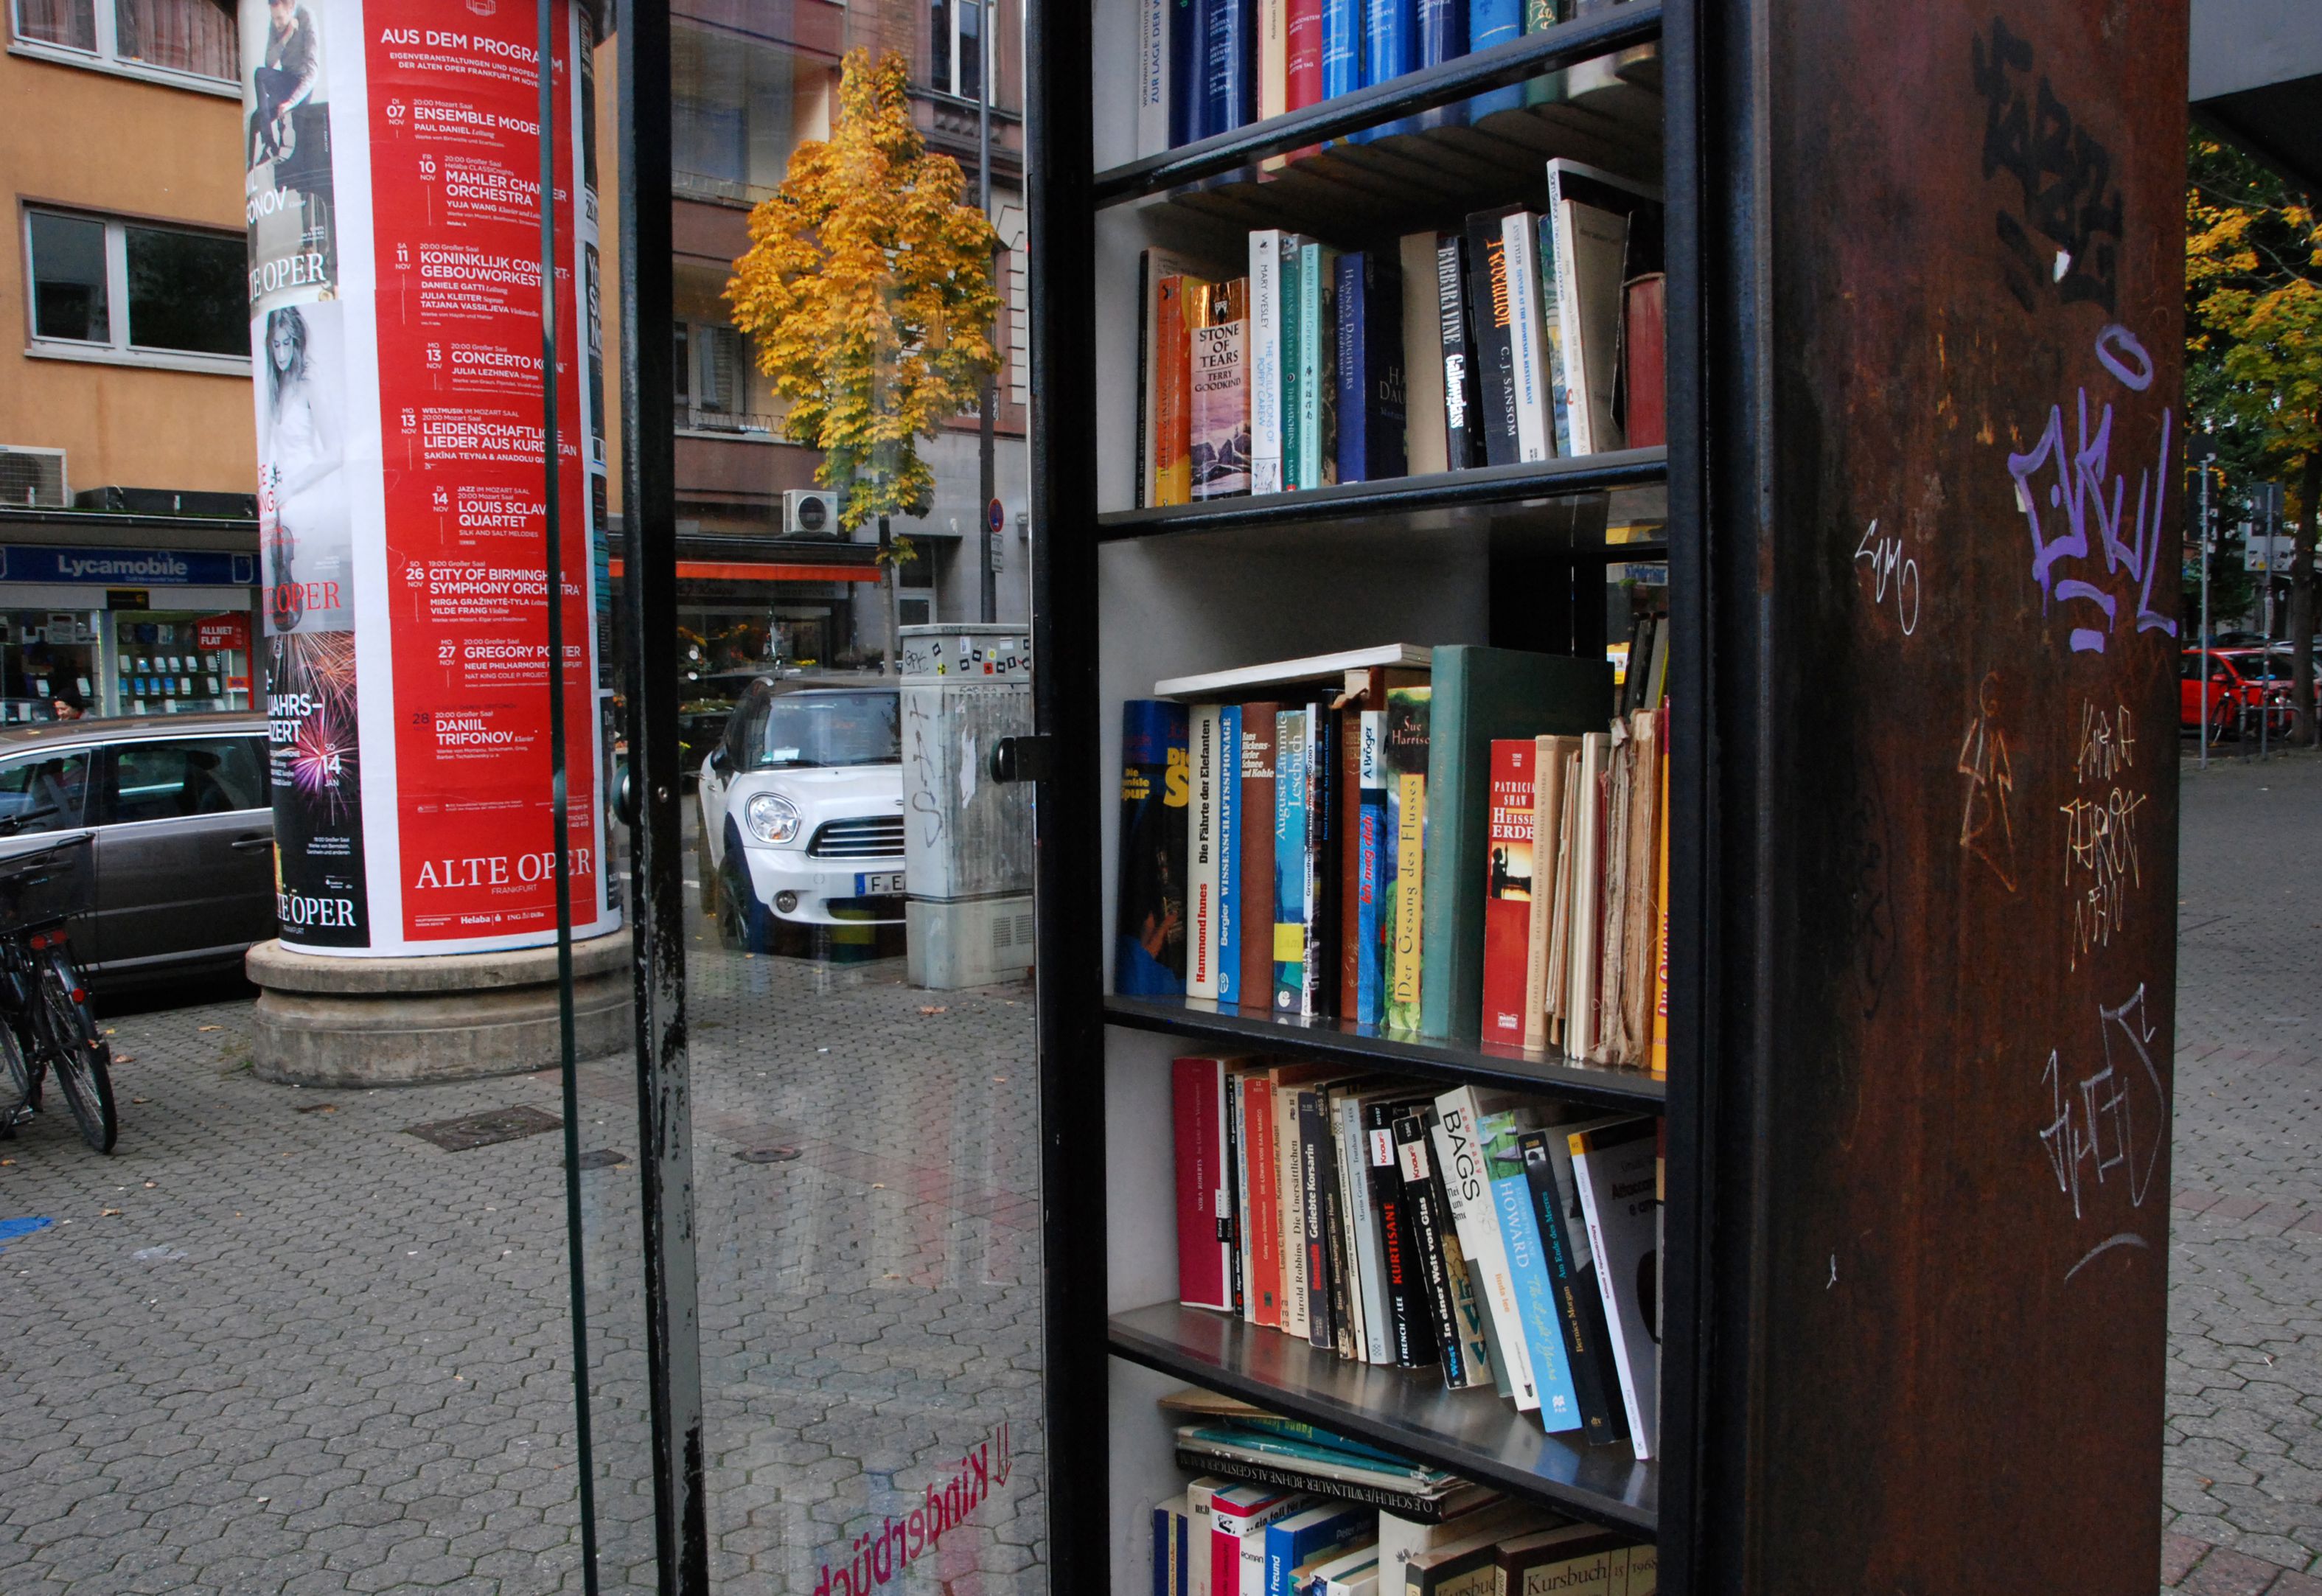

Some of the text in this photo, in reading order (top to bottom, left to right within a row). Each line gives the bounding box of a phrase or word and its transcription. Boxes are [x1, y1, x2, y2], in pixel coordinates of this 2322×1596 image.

[381, 29, 563, 72] AUS DEM PROGRAM
[390, 53, 490, 68] EIGENVERANSTALTUNGEN
[1151, 17, 1160, 104] ZUR LAGE DER
[417, 62, 442, 70] ALTEN
[468, 67, 510, 80] FRANKFURT
[387, 106, 405, 117] 07
[435, 100, 458, 109] Mozart
[414, 108, 495, 127] ENSEMBLE
[439, 125, 470, 135] DANIEL
[419, 162, 436, 173] 10
[446, 171, 506, 188] MAHLER
[447, 184, 532, 206] ORCHESTRA
[447, 201, 497, 212] YUJA WANG
[397, 251, 408, 262] 11
[421, 251, 509, 269] KONINKLIJK
[421, 265, 542, 287] GEBOUWORKEST
[422, 282, 459, 290] DANIELE
[1437, 246, 1461, 344] BARBARA VINE
[421, 301, 509, 313] TATJANA VASSILJEVA
[1261, 292, 1269, 329] WESLEY
[1199, 324, 1239, 342] STONE
[1345, 269, 1355, 390] HANNA'S DAUGHTERS
[1213, 339, 1230, 353] OF
[426, 350, 441, 361] 13
[452, 352, 531, 368] CONCERTO
[1200, 351, 1238, 368] TEARS
[478, 369, 519, 378] LEZHNEVA
[1207, 370, 1233, 382] TERRY
[1195, 377, 1241, 392] GOODKIND
[1524, 360, 1533, 405] RESTAURANT
[1446, 355, 1467, 429] Gallowglass
[1503, 378, 1518, 437] SANSOM
[401, 415, 416, 426] 13
[424, 437, 509, 450] LIEDER AUS
[497, 453, 534, 462] ANADOLU
[433, 493, 448, 504] 14
[459, 501, 502, 513] LOUIS
[459, 515, 526, 528] QUARTET
[59, 554, 187, 576] Lycamobile
[406, 568, 424, 579] 26
[430, 568, 486, 581] CITY OF
[430, 583, 510, 594] SYMPHONY
[201, 627, 232, 635] ALLNET
[439, 647, 456, 658] 27
[464, 647, 533, 658] GREGORY
[413, 714, 429, 723] 28
[436, 719, 486, 731] DANIIL
[1404, 717, 1421, 732] Sue
[436, 732, 513, 745] TRIFONOV
[1362, 726, 1373, 767] Bröger
[321, 755, 341, 774] 14
[1242, 760, 1263, 768] Schnee
[1289, 735, 1302, 807] Lesebuch
[1252, 770, 1274, 778] Kohle
[1199, 719, 1210, 864] Die Fährte der Elefanten
[1504, 795, 1527, 805] SHAW
[1220, 717, 1231, 947] Bergier WISSENSCHAFTSSPIONAGE
[1360, 815, 1375, 905] Ich mag dich
[415, 857, 509, 888] ALTE
[492, 885, 537, 894] FRANKFURT
[872, 877, 881, 891] F
[1398, 780, 1418, 997] Der Gesang des Flusses
[461, 916, 490, 924] Helaba
[1196, 883, 1207, 983] Hammond Innes
[1459, 1107, 1483, 1174] sew easy
[1443, 1109, 1481, 1202] BAGS
[1305, 1143, 1319, 1238] Geliebte Korsarin
[1289, 1140, 1305, 1323] Harold Robbins Die Unersättlichen
[1499, 1181, 1530, 1268] HOWARD
[1541, 1191, 1567, 1279] Am Ende des Meeres
[1331, 1235, 1341, 1284] Bemerkungen
[1384, 1202, 1409, 1359] FRENCH LEE KURTISANE
[1418, 1196, 1459, 1378] West In einer Welt von Glas
[1494, 1273, 1511, 1313] linda lee
[1563, 1285, 1584, 1353] Bernice Morgan
[1252, 1468, 1363, 1500] WILLNAUER ALS
[1241, 1551, 1263, 1563] ROMAN
[1271, 1555, 1280, 1591] Freund
[1527, 1558, 1607, 1595] Kursbuch
